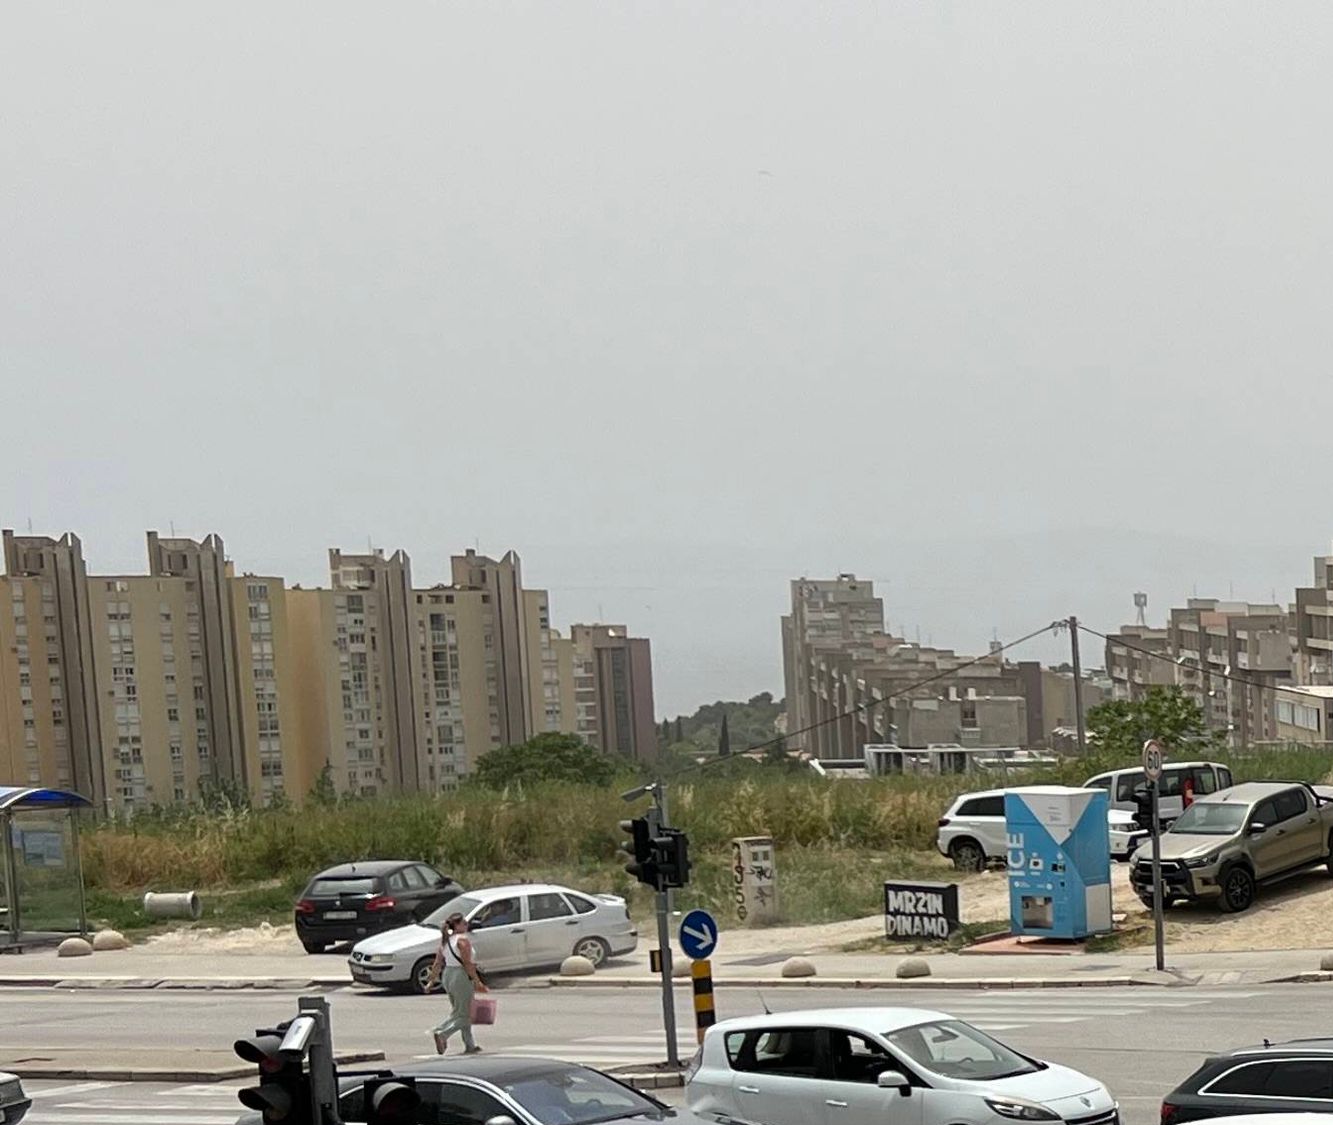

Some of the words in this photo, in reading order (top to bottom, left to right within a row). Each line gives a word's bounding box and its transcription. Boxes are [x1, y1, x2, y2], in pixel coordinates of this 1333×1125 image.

[1147, 750, 1160, 769] 60
[1007, 833, 1026, 877] ICE
[888, 889, 943, 914] MRZIN
[886, 914, 949, 938] DINAMO
